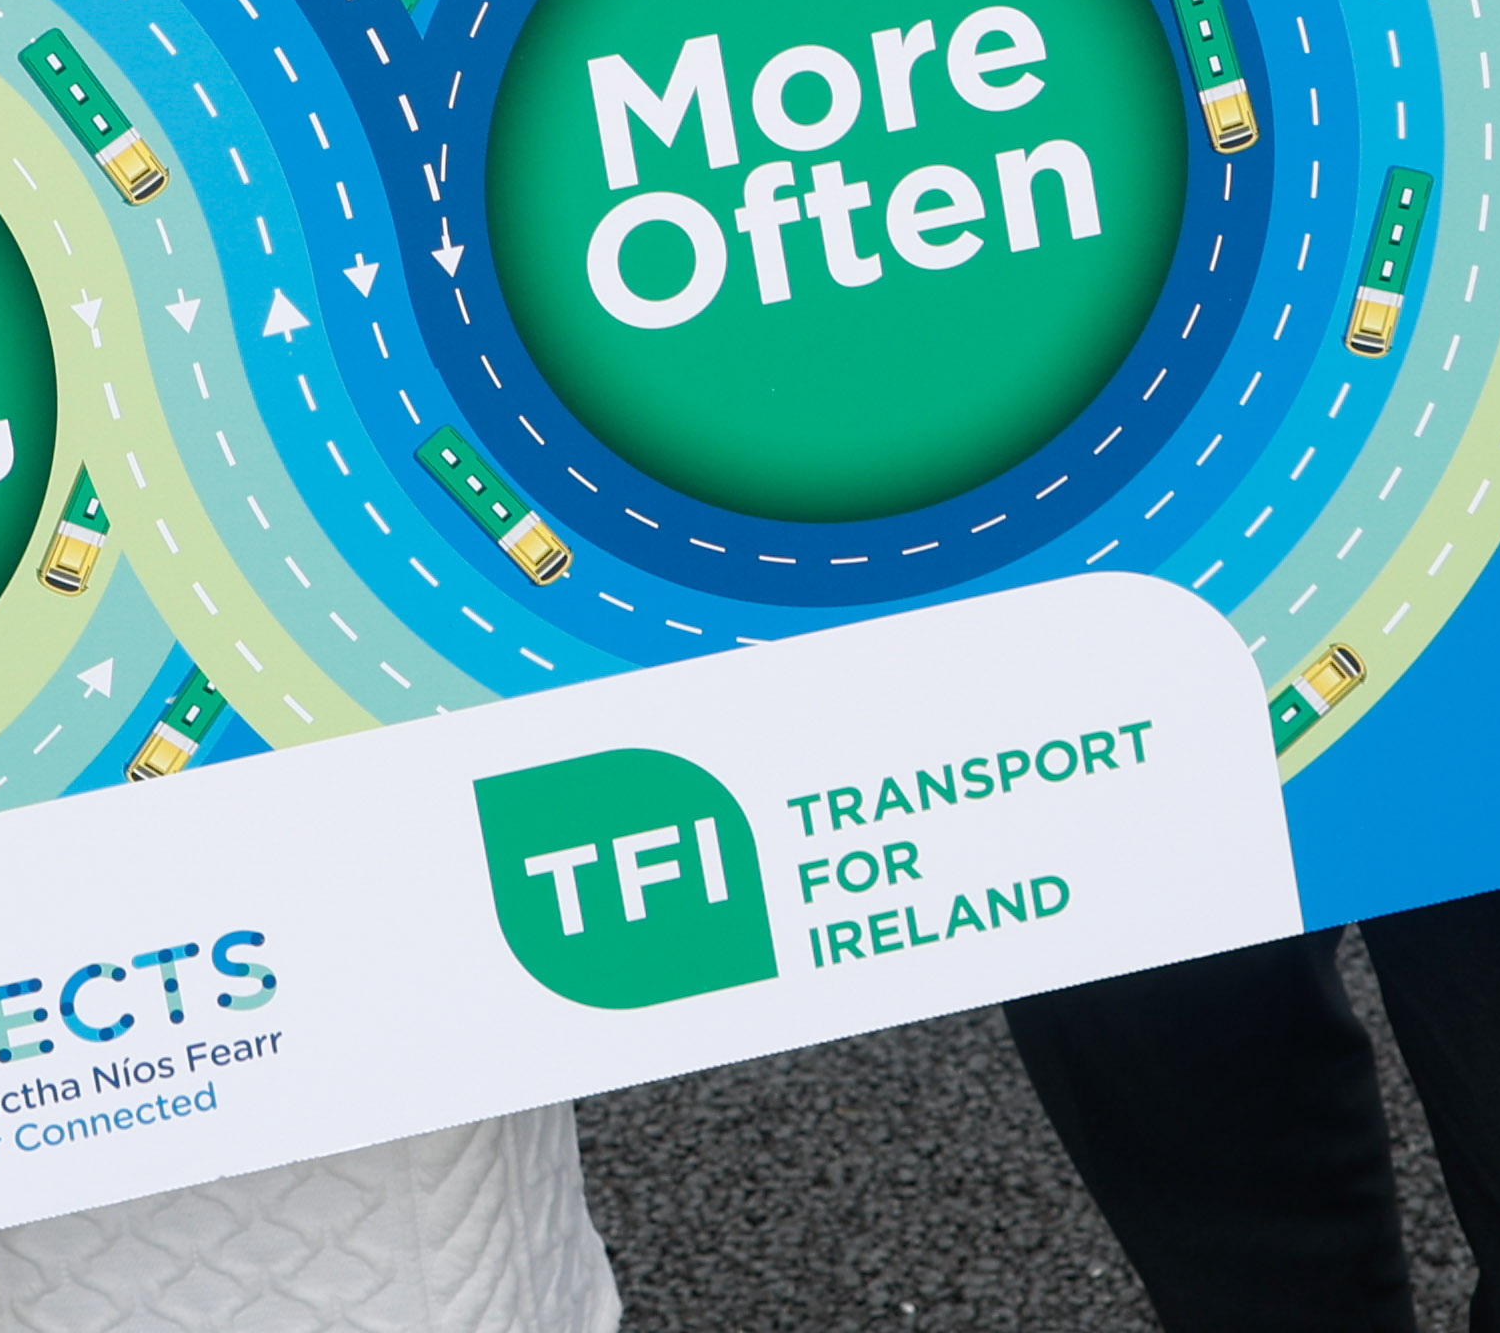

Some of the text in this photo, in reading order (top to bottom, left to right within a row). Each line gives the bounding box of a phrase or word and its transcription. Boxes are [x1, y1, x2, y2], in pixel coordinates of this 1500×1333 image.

[587, 4, 1047, 191] More
[586, 138, 1102, 330] Often
[787, 720, 1153, 837] TRANSPORT
[524, 816, 729, 937] TFI
[798, 840, 923, 905] FOR
[808, 875, 1071, 969] IRELAND
[92, 1055, 175, 1094] Níos
[186, 1031, 283, 1072] Fearr
[14, 1081, 218, 1152] Connected
